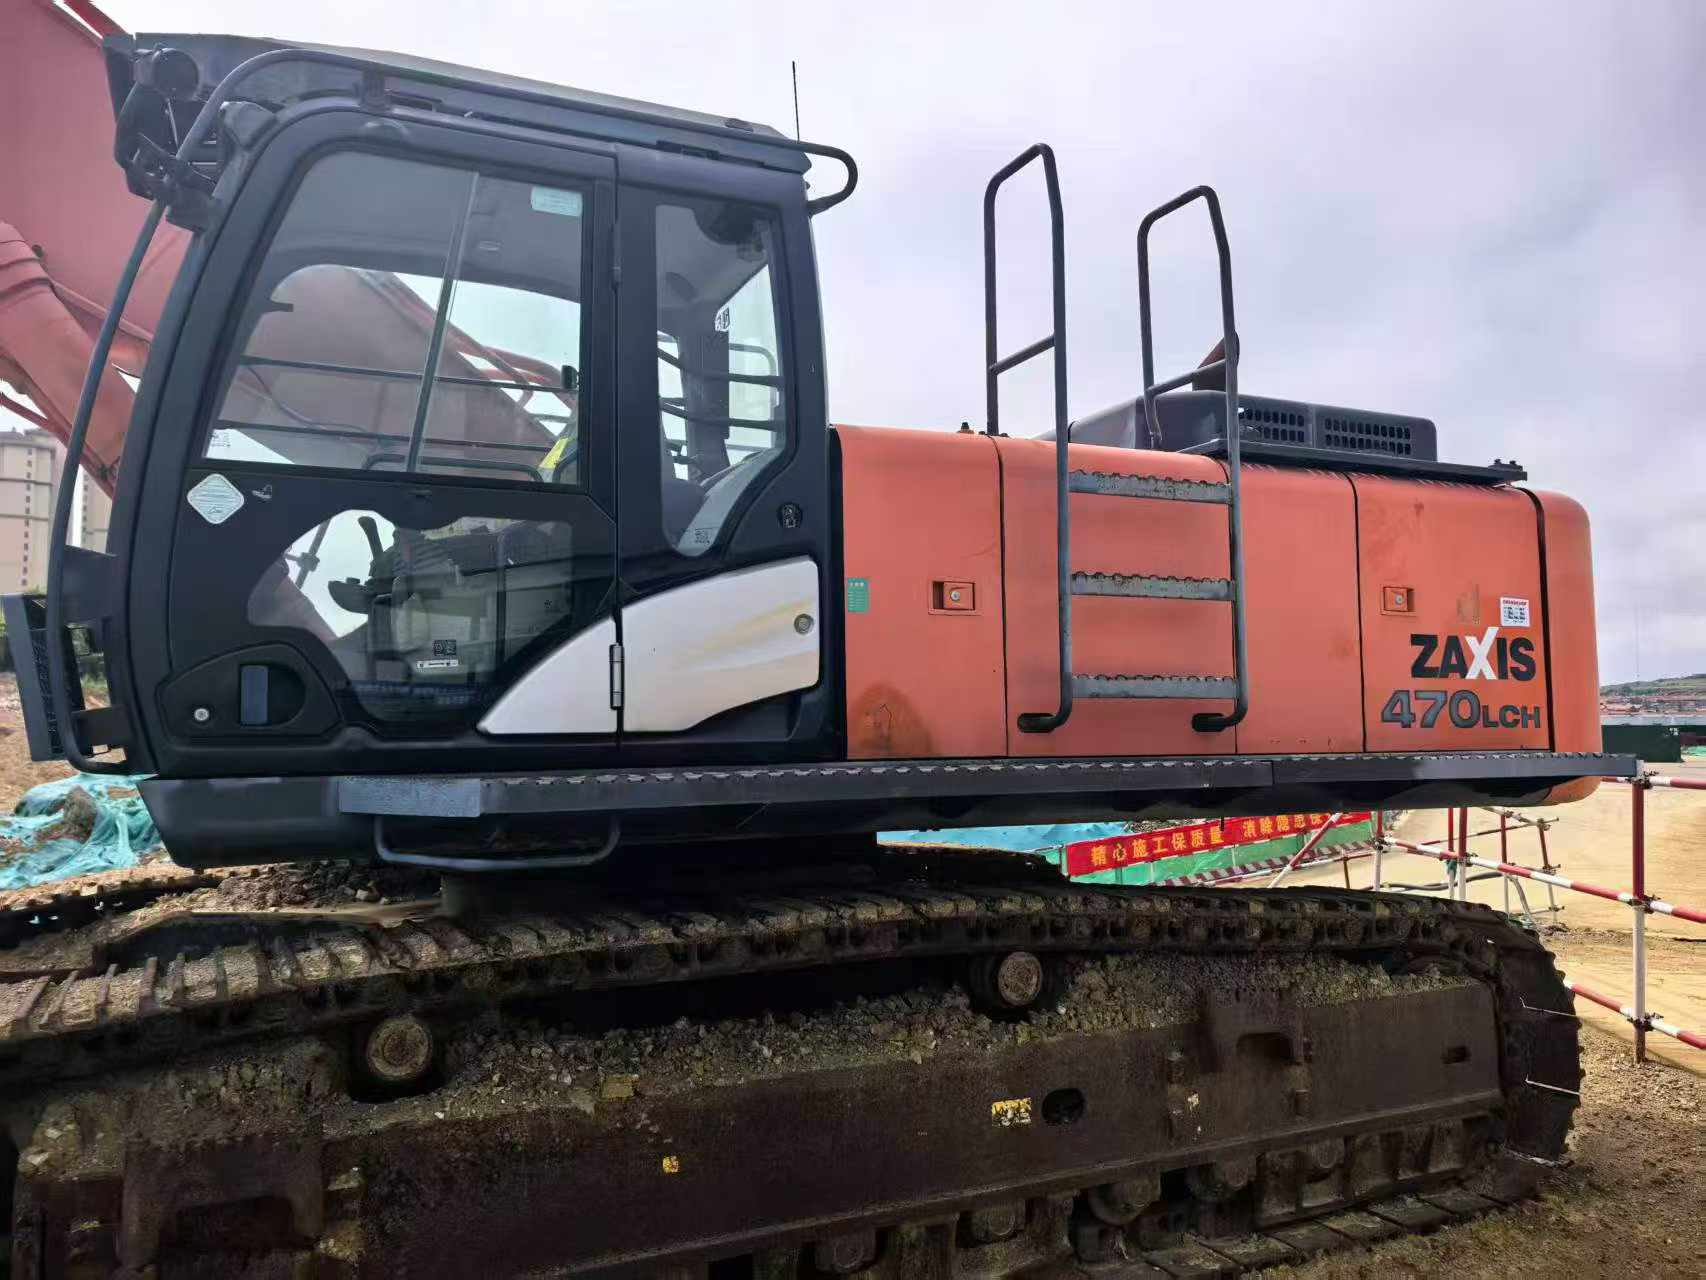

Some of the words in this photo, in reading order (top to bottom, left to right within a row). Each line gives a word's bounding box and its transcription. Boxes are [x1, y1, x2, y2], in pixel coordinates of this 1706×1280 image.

[1410, 626, 1537, 681] ZAXIS
[1380, 689, 1541, 729] 470LCH
[1091, 825, 1224, 867] 精心施工保质量
